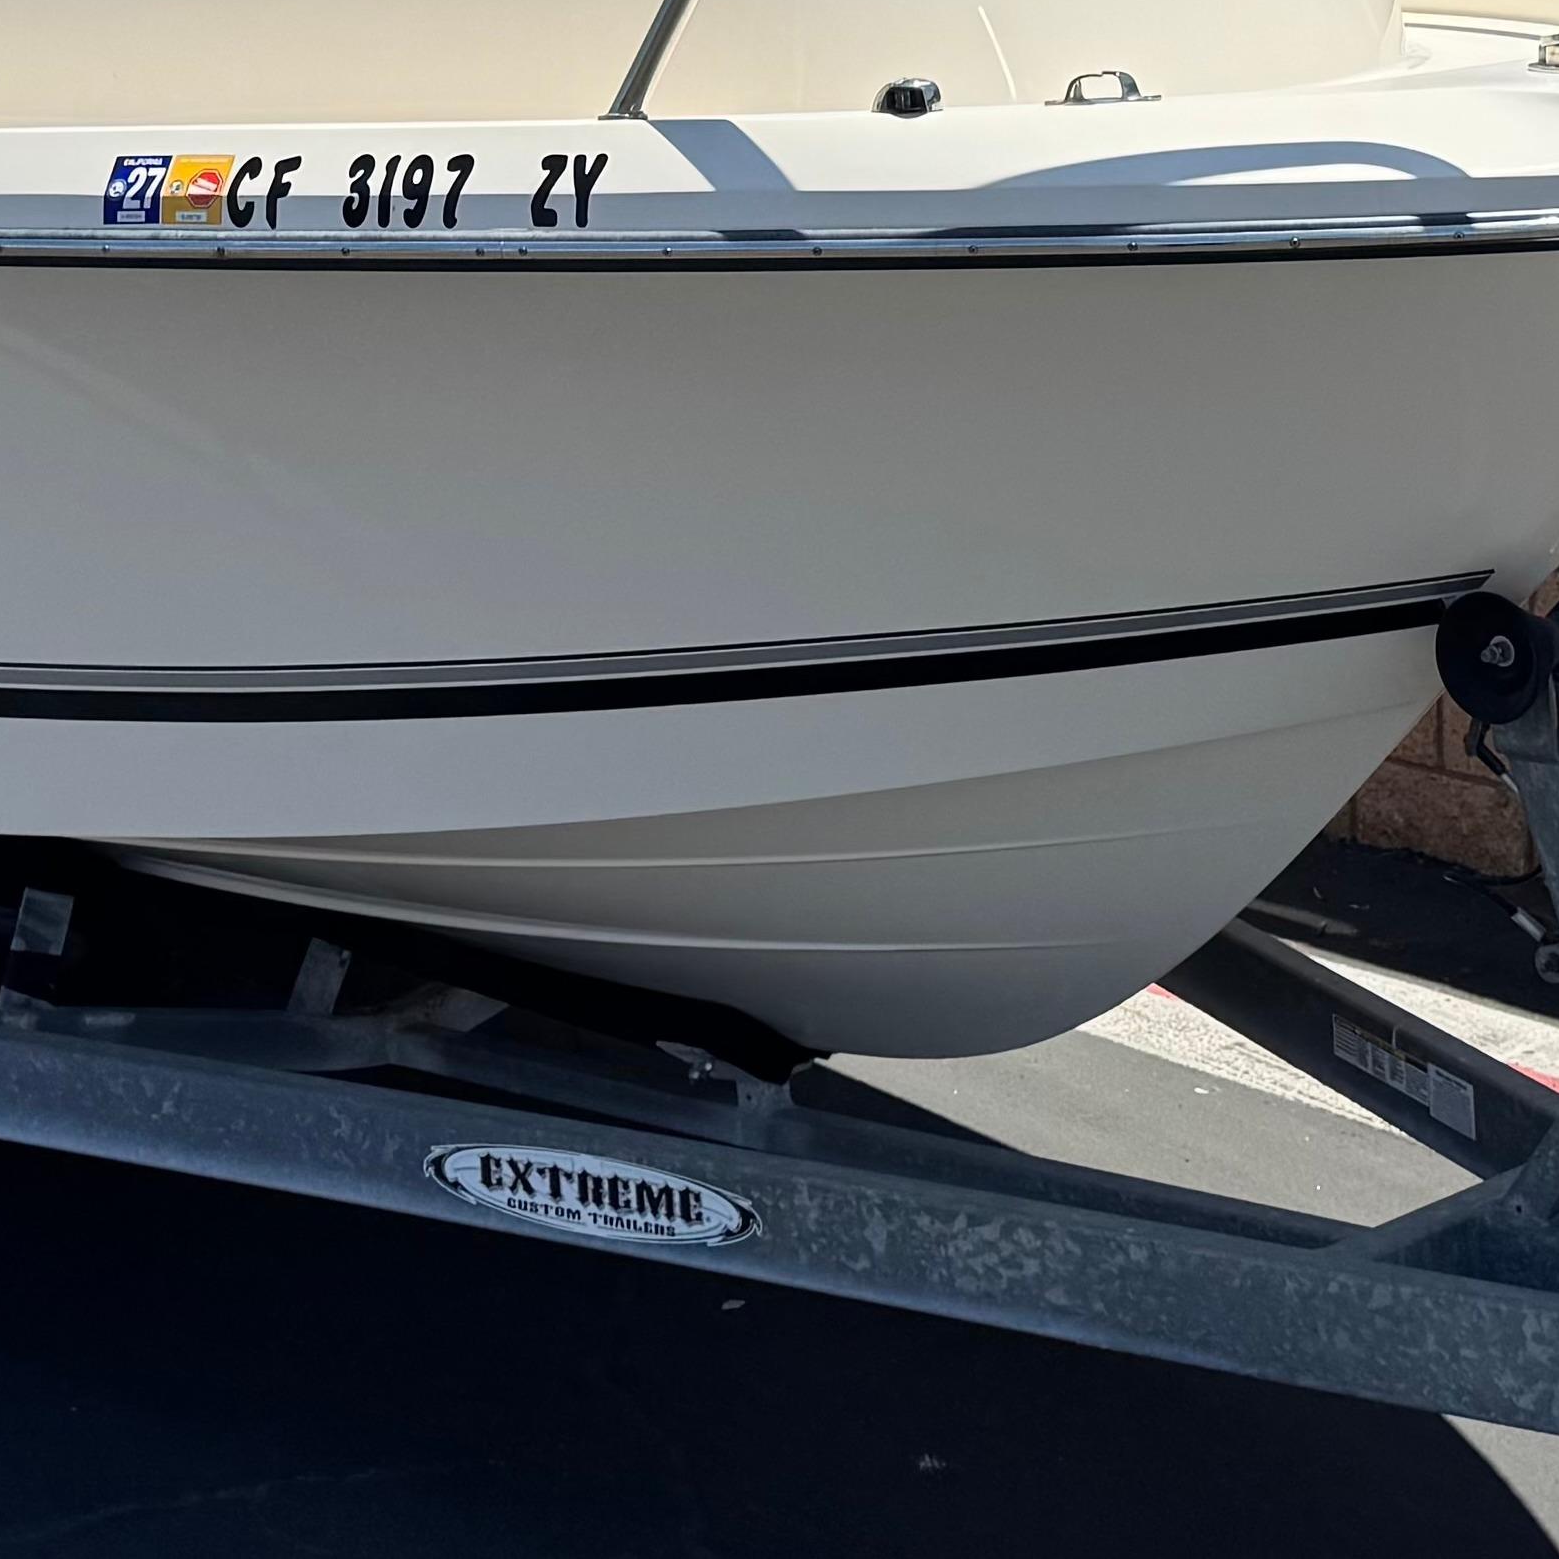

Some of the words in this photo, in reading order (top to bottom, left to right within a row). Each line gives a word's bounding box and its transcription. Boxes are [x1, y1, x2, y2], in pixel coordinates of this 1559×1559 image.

[122, 167, 166, 209] 27
[226, 155, 302, 230] CF
[343, 153, 475, 229] 3197
[530, 153, 609, 228] ZY
[479, 1152, 704, 1226] EXTREME
[506, 1197, 582, 1221] CUSTOM
[588, 1212, 677, 1237] TRAILERS
